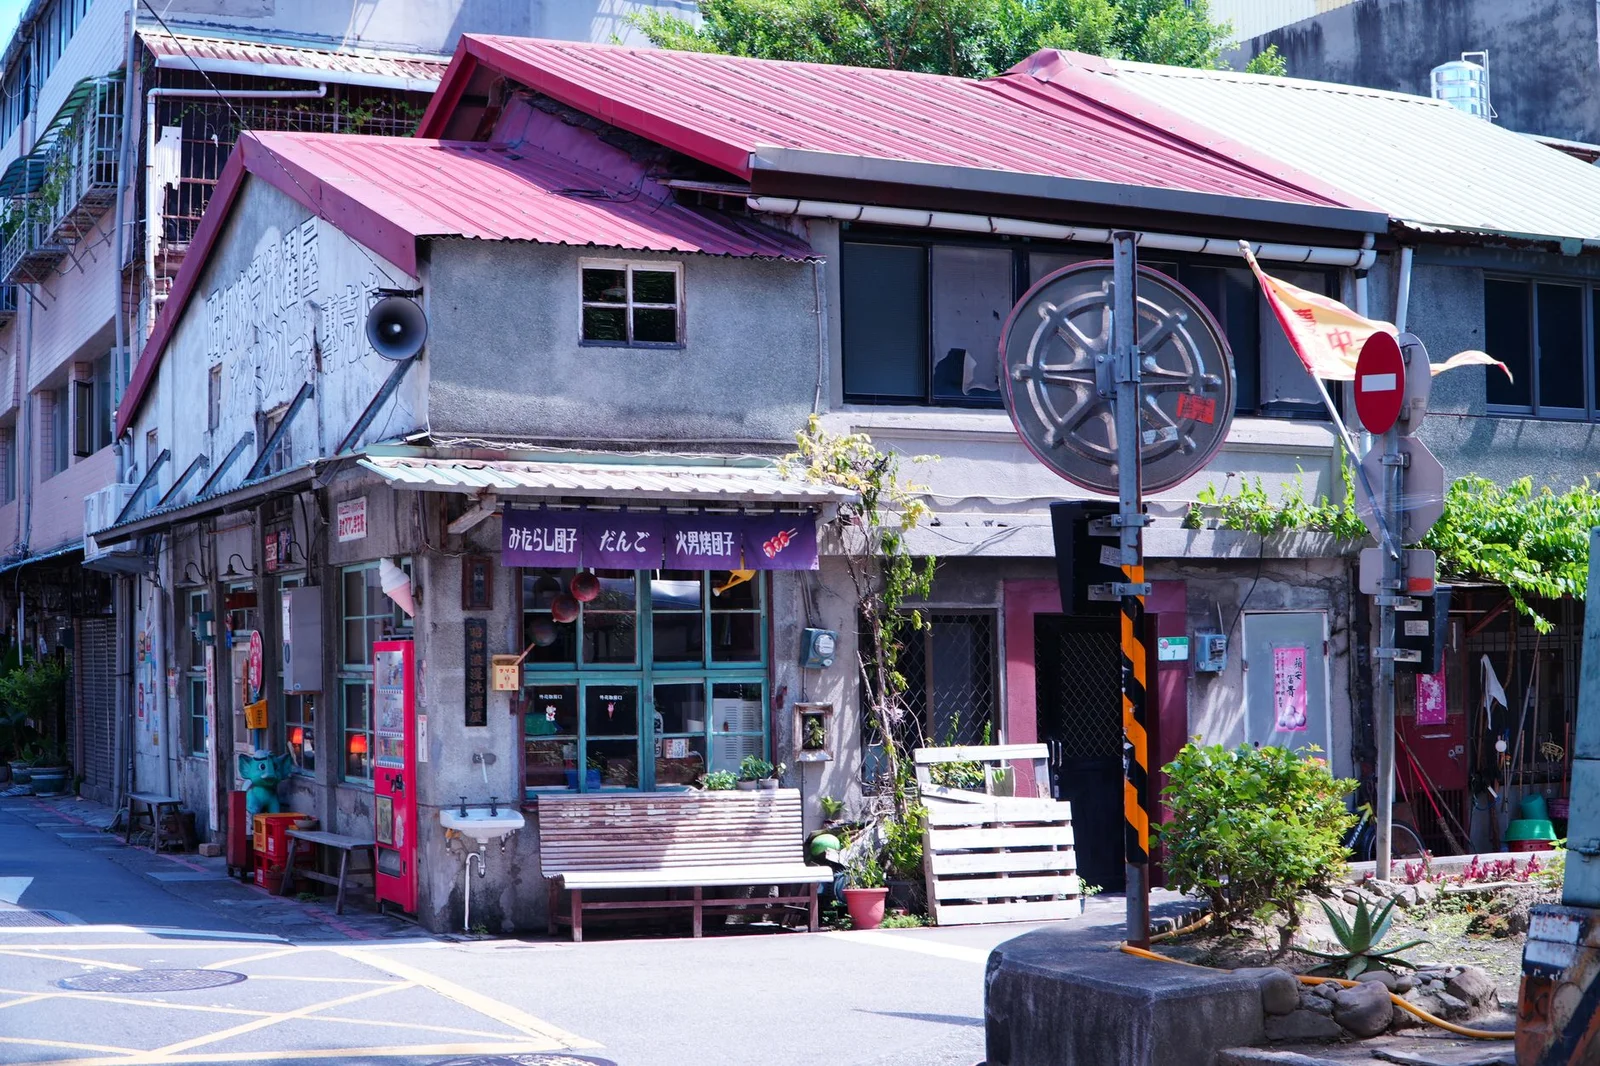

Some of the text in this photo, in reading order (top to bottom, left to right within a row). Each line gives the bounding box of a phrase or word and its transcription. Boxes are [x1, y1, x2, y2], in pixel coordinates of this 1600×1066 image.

[508, 527, 578, 553] みたらし団子
[599, 529, 651, 553] だんご
